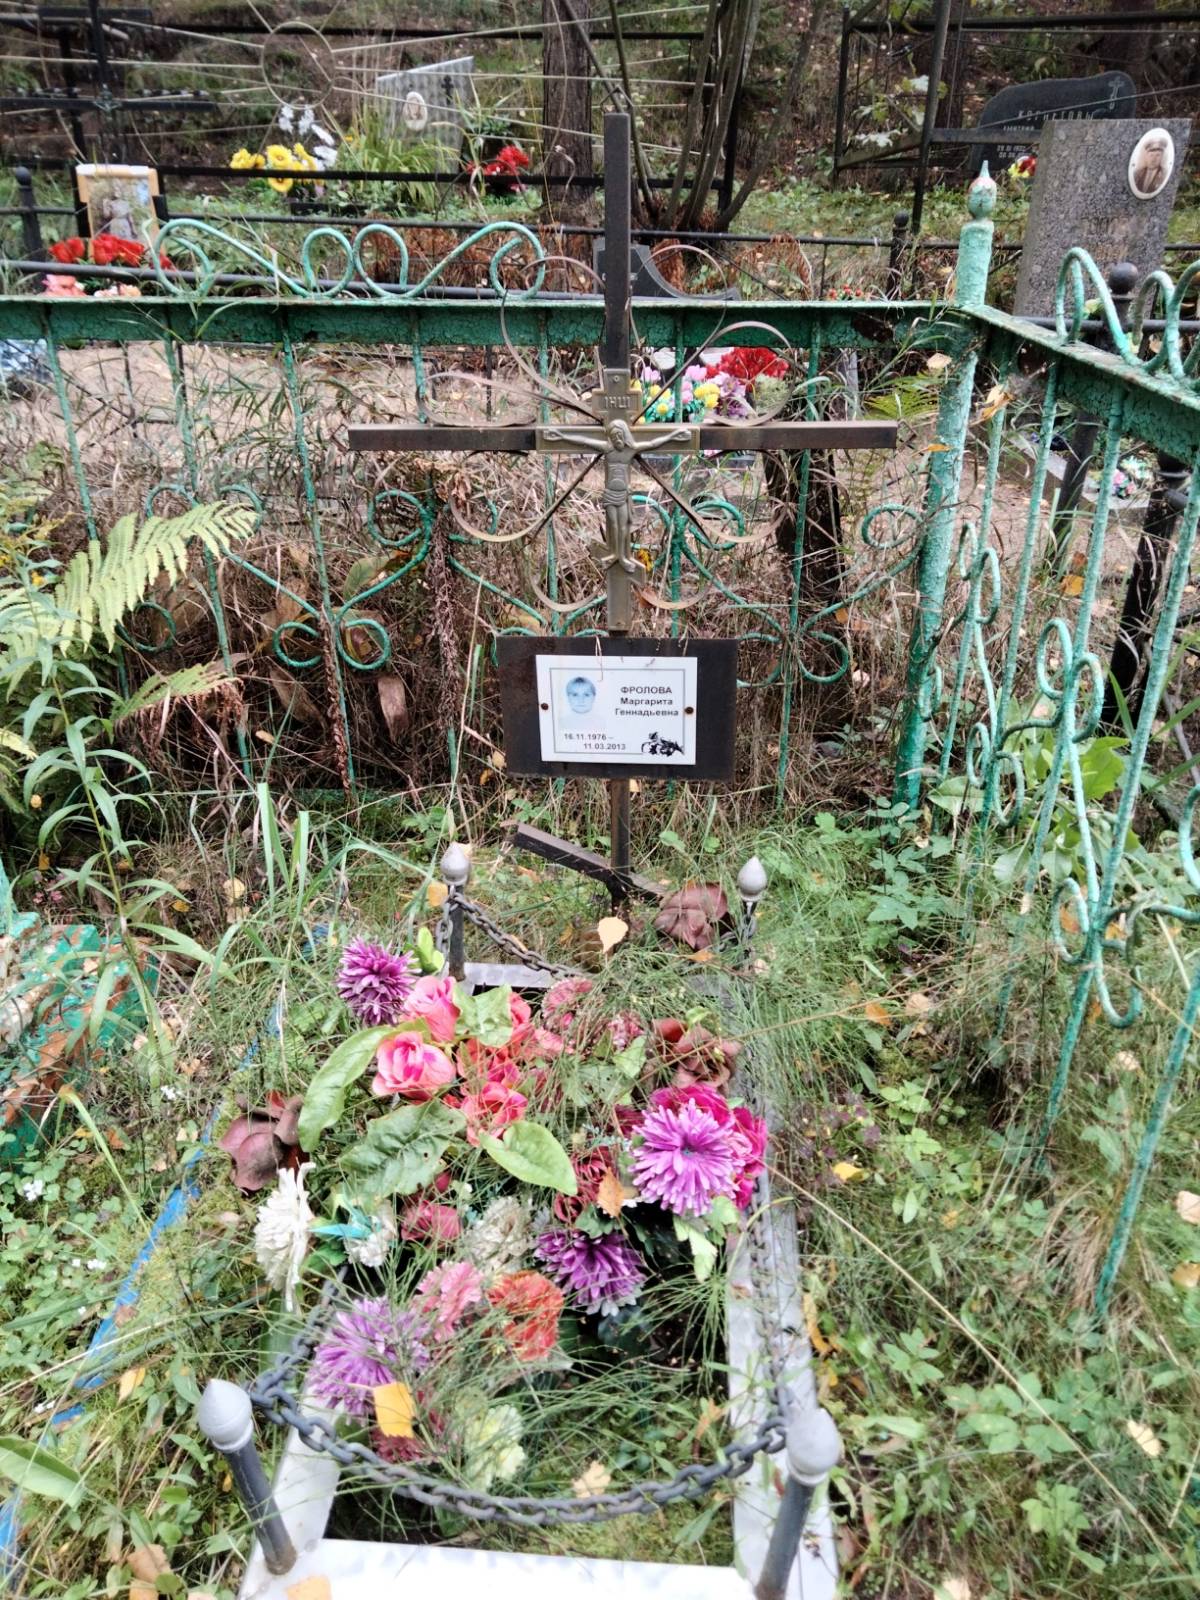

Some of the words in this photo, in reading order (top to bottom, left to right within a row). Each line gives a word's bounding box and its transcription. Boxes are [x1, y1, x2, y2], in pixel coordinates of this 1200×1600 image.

[620, 686, 673, 694] ФРОЛОВА
[620, 697, 673, 706] Маргарита
[615, 708, 679, 717] Геннадьевна
[564, 733, 607, 741] 16.11.1976
[583, 743, 626, 751] 11.03.2013
